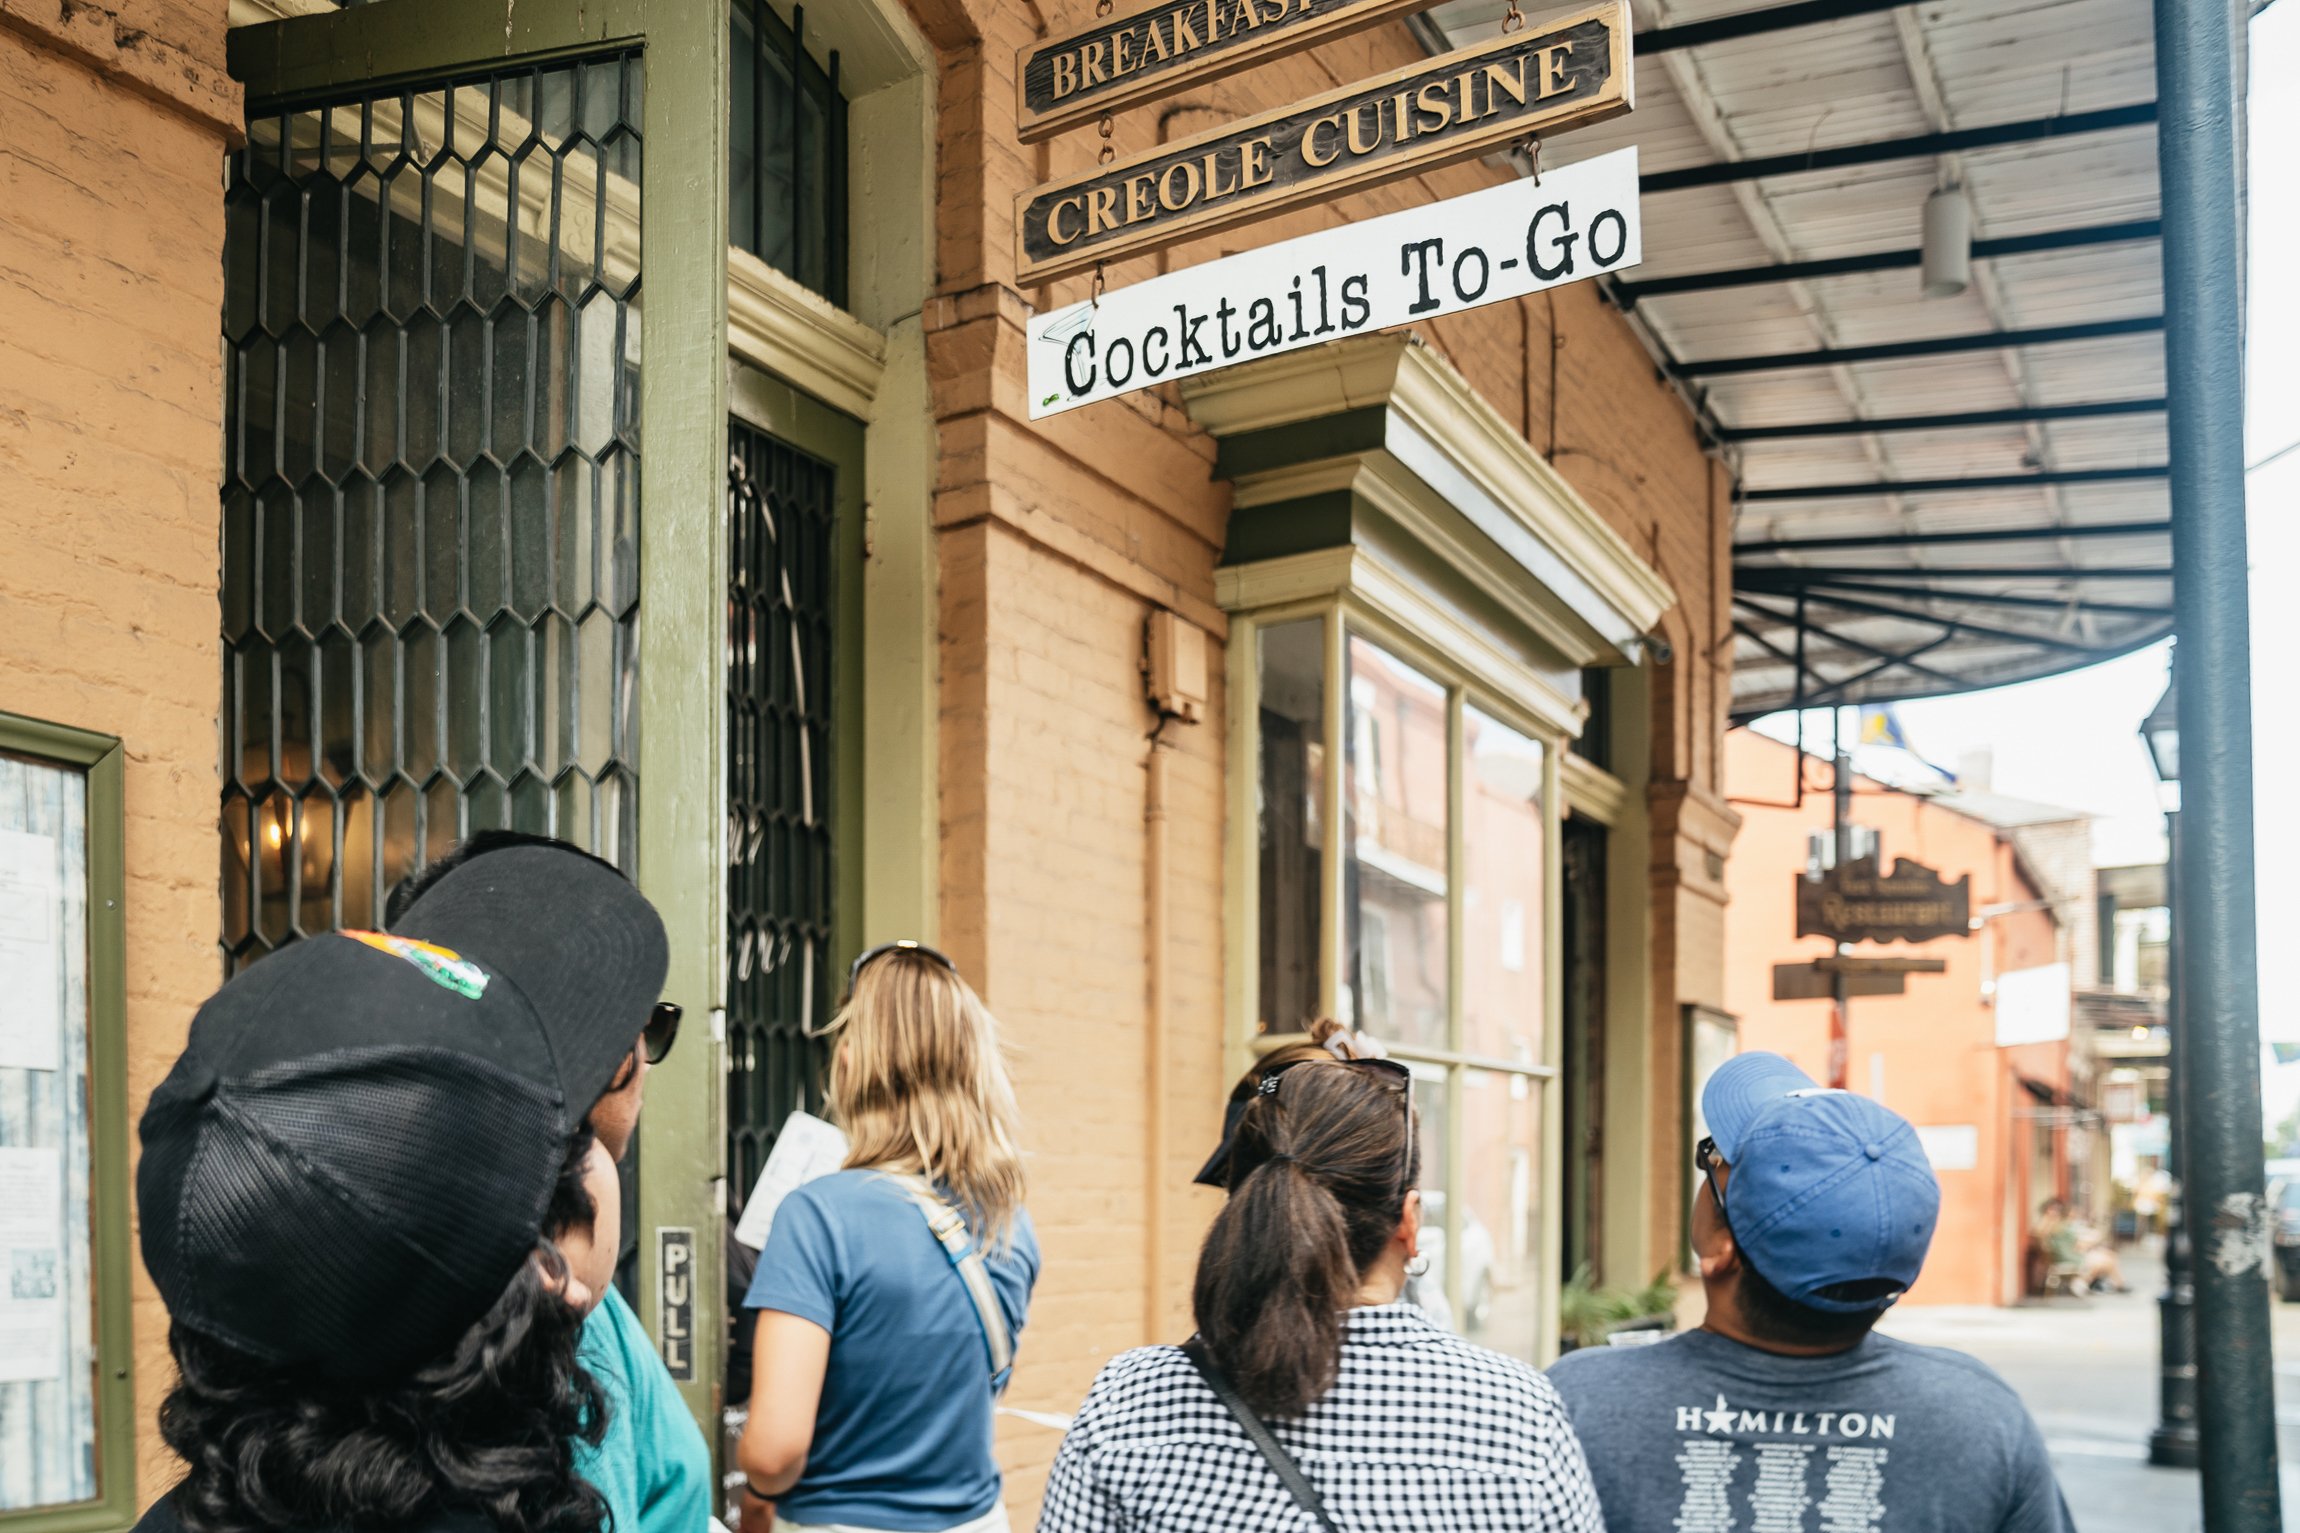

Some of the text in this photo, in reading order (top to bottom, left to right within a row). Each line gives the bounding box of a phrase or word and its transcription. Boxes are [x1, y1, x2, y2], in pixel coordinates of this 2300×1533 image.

[1046, 40, 1578, 246] CREOLE CUISINE
[1063, 200, 1628, 398] Cocktails To-Go
[665, 1243, 689, 1370] PULL
